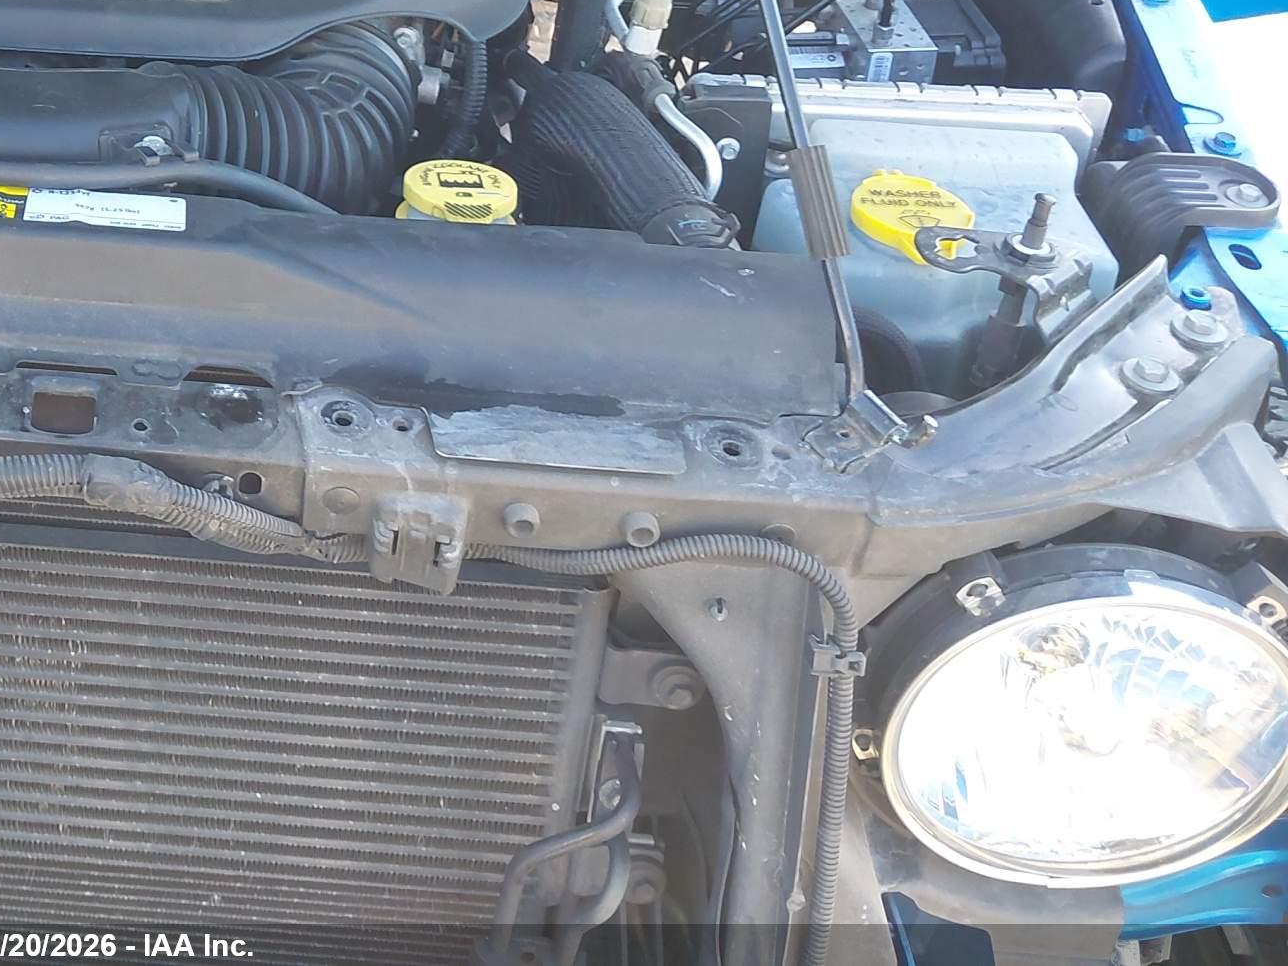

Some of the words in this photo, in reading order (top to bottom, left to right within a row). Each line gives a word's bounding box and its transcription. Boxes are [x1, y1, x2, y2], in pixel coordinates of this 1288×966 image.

[433, 162, 488, 174] COOLANT
[869, 189, 941, 198] WASHER
[861, 197, 910, 207] FLUID
[914, 200, 957, 209] ONLY
